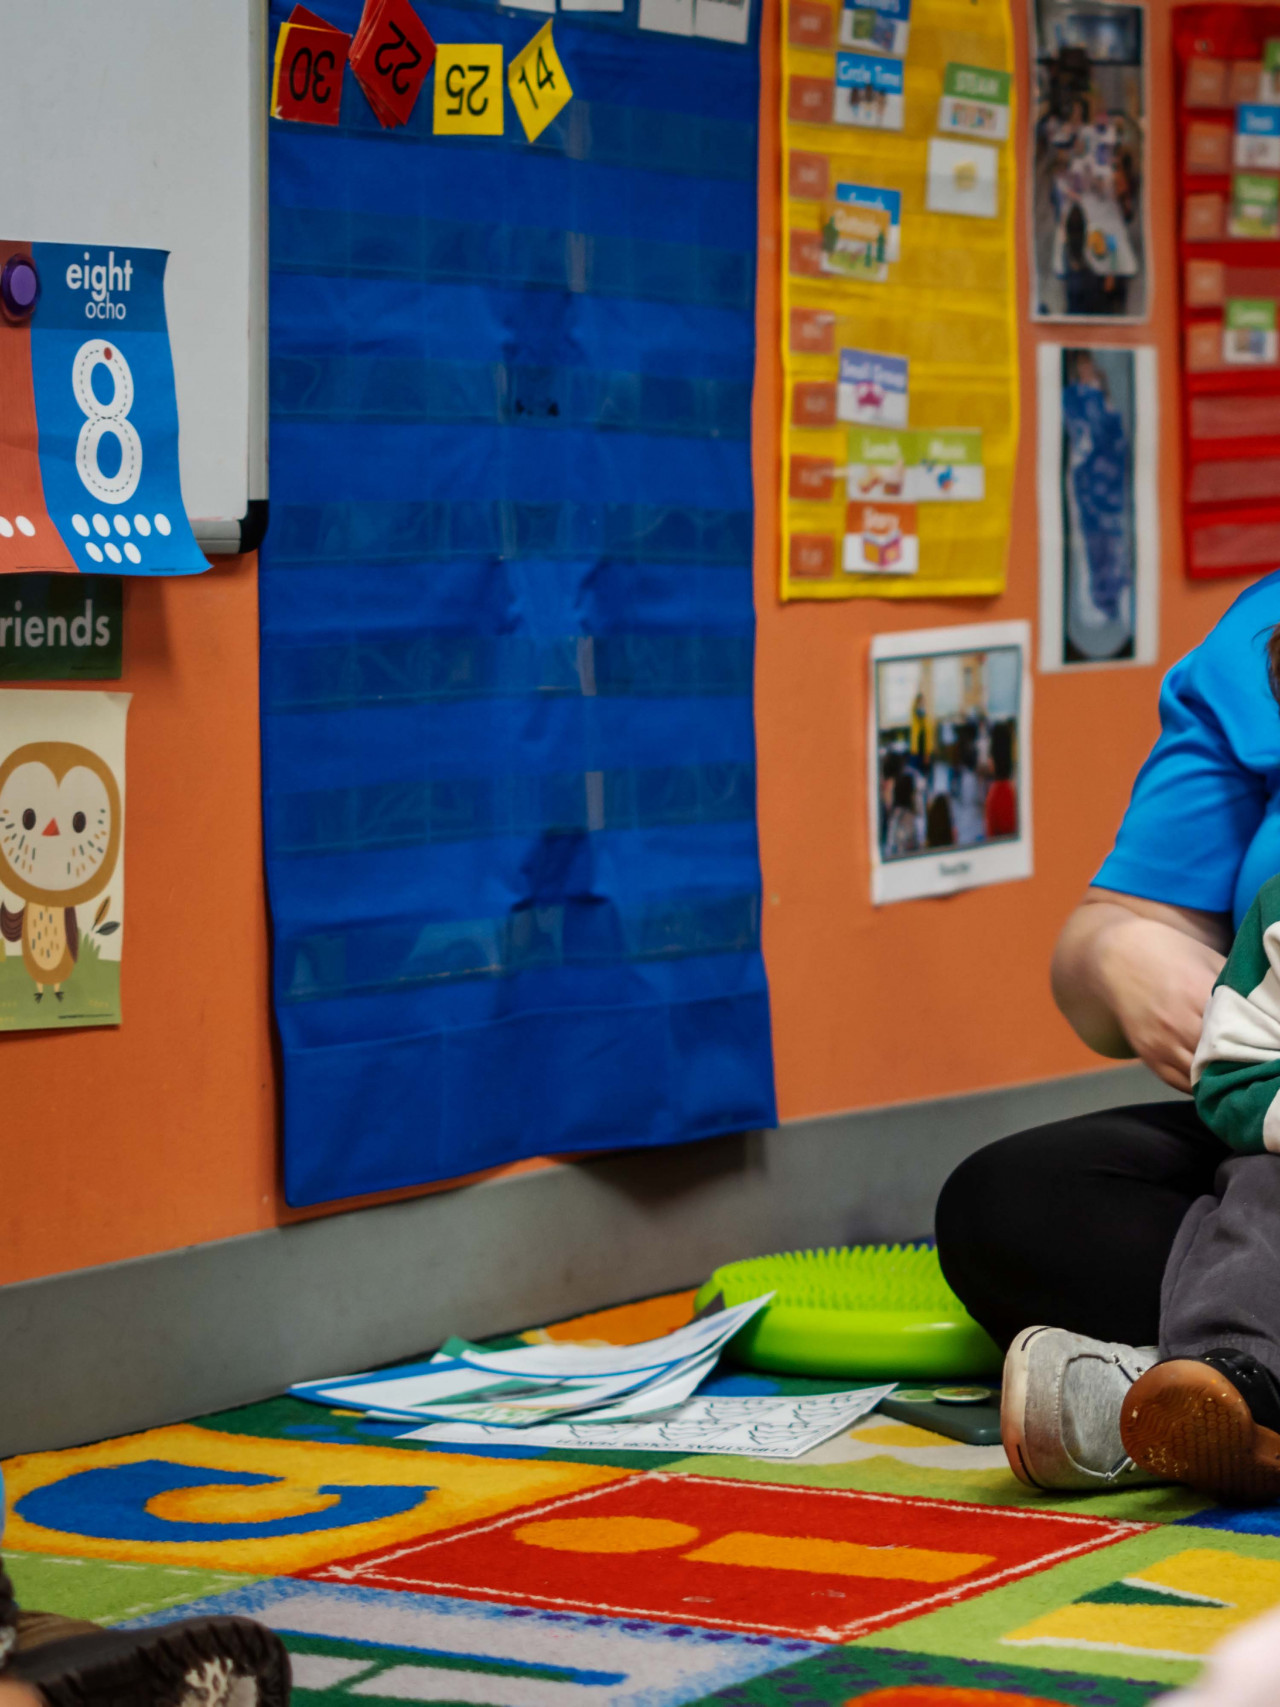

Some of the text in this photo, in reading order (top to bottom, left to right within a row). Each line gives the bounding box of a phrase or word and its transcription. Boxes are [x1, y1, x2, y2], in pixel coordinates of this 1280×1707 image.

[289, 47, 335, 103] 30
[375, 21, 421, 94] 22
[519, 46, 555, 109] 14
[446, 64, 489, 116] 25
[66, 251, 133, 301] eight
[85, 292, 126, 320] ocho
[71, 338, 142, 504] 8
[0, 599, 110, 647] riends
